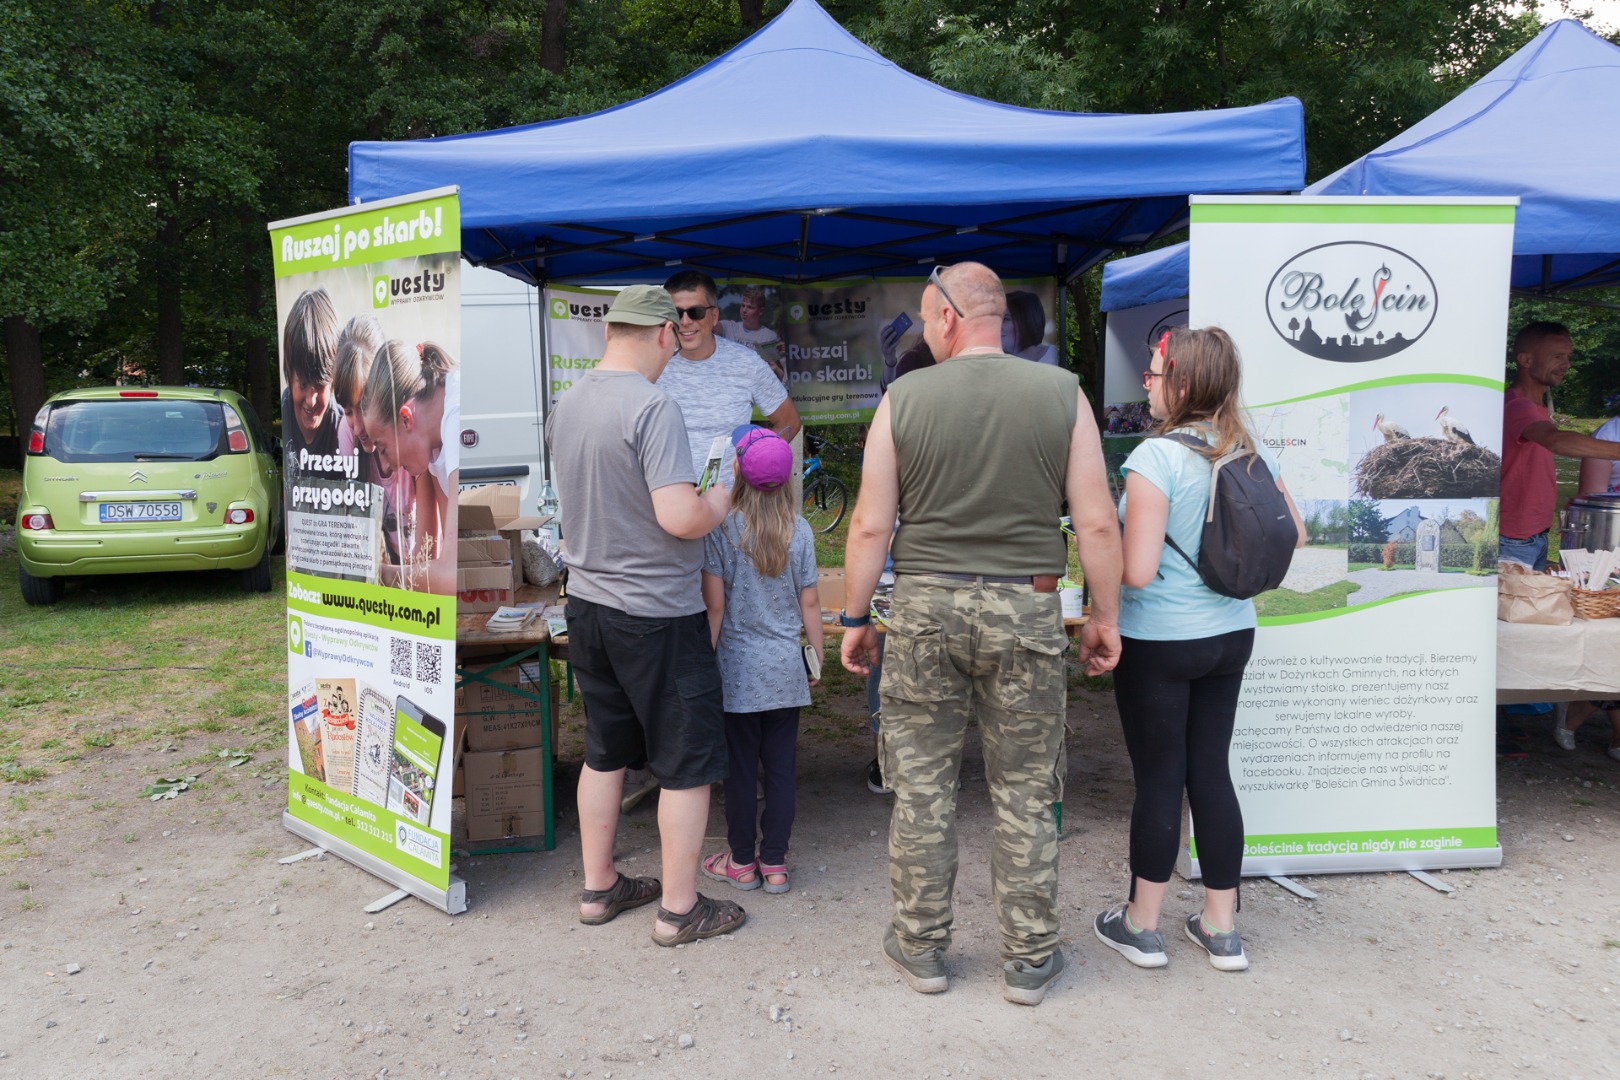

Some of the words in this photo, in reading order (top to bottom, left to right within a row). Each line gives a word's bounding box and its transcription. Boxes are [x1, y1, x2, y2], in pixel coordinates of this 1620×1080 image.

[282, 223, 340, 262] Ruszaj
[344, 228, 370, 259] po
[373, 207, 442, 247] skarb!
[390, 297, 412, 305] WYPRAWY
[554, 302, 610, 317] Quest
[789, 341, 848, 361] Ruszaj
[790, 370, 812, 387] po
[817, 364, 872, 382] skarb!
[846, 392, 878, 400] terenowe
[300, 447, 359, 479] Przeżyj
[292, 483, 370, 511] przygodę!
[108, 505, 133, 517] DSW
[138, 505, 179, 517] 70558
[288, 581, 320, 605] Zobacz:
[322, 593, 440, 628] www.questy.com.pl
[1257, 656, 1297, 666] również
[1310, 654, 1382, 667] kultywowanie
[1386, 653, 1427, 666] tradycji.
[1430, 653, 1477, 664] Bierzemy
[1280, 670, 1339, 680] Dożynkach
[1342, 668, 1399, 679] Gminnych,
[1419, 667, 1459, 678] których
[393, 679, 410, 689] Android
[1244, 684, 1308, 695] wystawiamy
[1351, 682, 1422, 694] prezentujemy
[1425, 682, 1448, 690] nasz
[1292, 697, 1347, 708] wykonany
[1349, 696, 1390, 706] wieniec
[1393, 694, 1452, 705] dożynkowy
[1456, 695, 1478, 704] oraz
[1275, 711, 1331, 722] serwujemy
[1334, 710, 1372, 720] lokalne
[1375, 709, 1416, 720] wyroby.
[1295, 723, 1340, 734] Państwa
[1343, 724, 1357, 733] do
[1361, 722, 1428, 733] odwiedzenia
[1430, 721, 1463, 732] naszej
[1232, 738, 1305, 751] miejscowości.
[1308, 738, 1318, 748] O
[1320, 737, 1374, 749] wszystkich
[1377, 736, 1433, 747] atrakcjach
[1436, 736, 1459, 744] oraz
[1240, 752, 1315, 765] wydarzeniach
[1318, 751, 1382, 763] informujemy
[1385, 751, 1399, 759] na
[1402, 749, 1433, 761] profilu
[1436, 750, 1451, 758] na
[1243, 766, 1305, 777] facebooku.
[1308, 765, 1366, 777] Znajdziecie
[1369, 765, 1387, 773] nas
[1391, 763, 1435, 775] wpisując
[1238, 780, 1309, 793] wyszukiwarkę
[1312, 779, 1357, 789] "Boleścin
[1361, 778, 1396, 788] Gmina
[325, 794, 349, 812] Fundacja
[350, 803, 377, 822] Calamita
[357, 821, 368, 833] 512
[369, 825, 380, 838] 312
[381, 830, 393, 844] 215
[408, 829, 439, 849] FUNDACJA
[1243, 842, 1304, 855] Boleścinie
[1307, 840, 1358, 854] tradycja
[1362, 839, 1395, 852] nigdy
[1399, 838, 1417, 849] nie
[1420, 836, 1462, 850] zaginie
